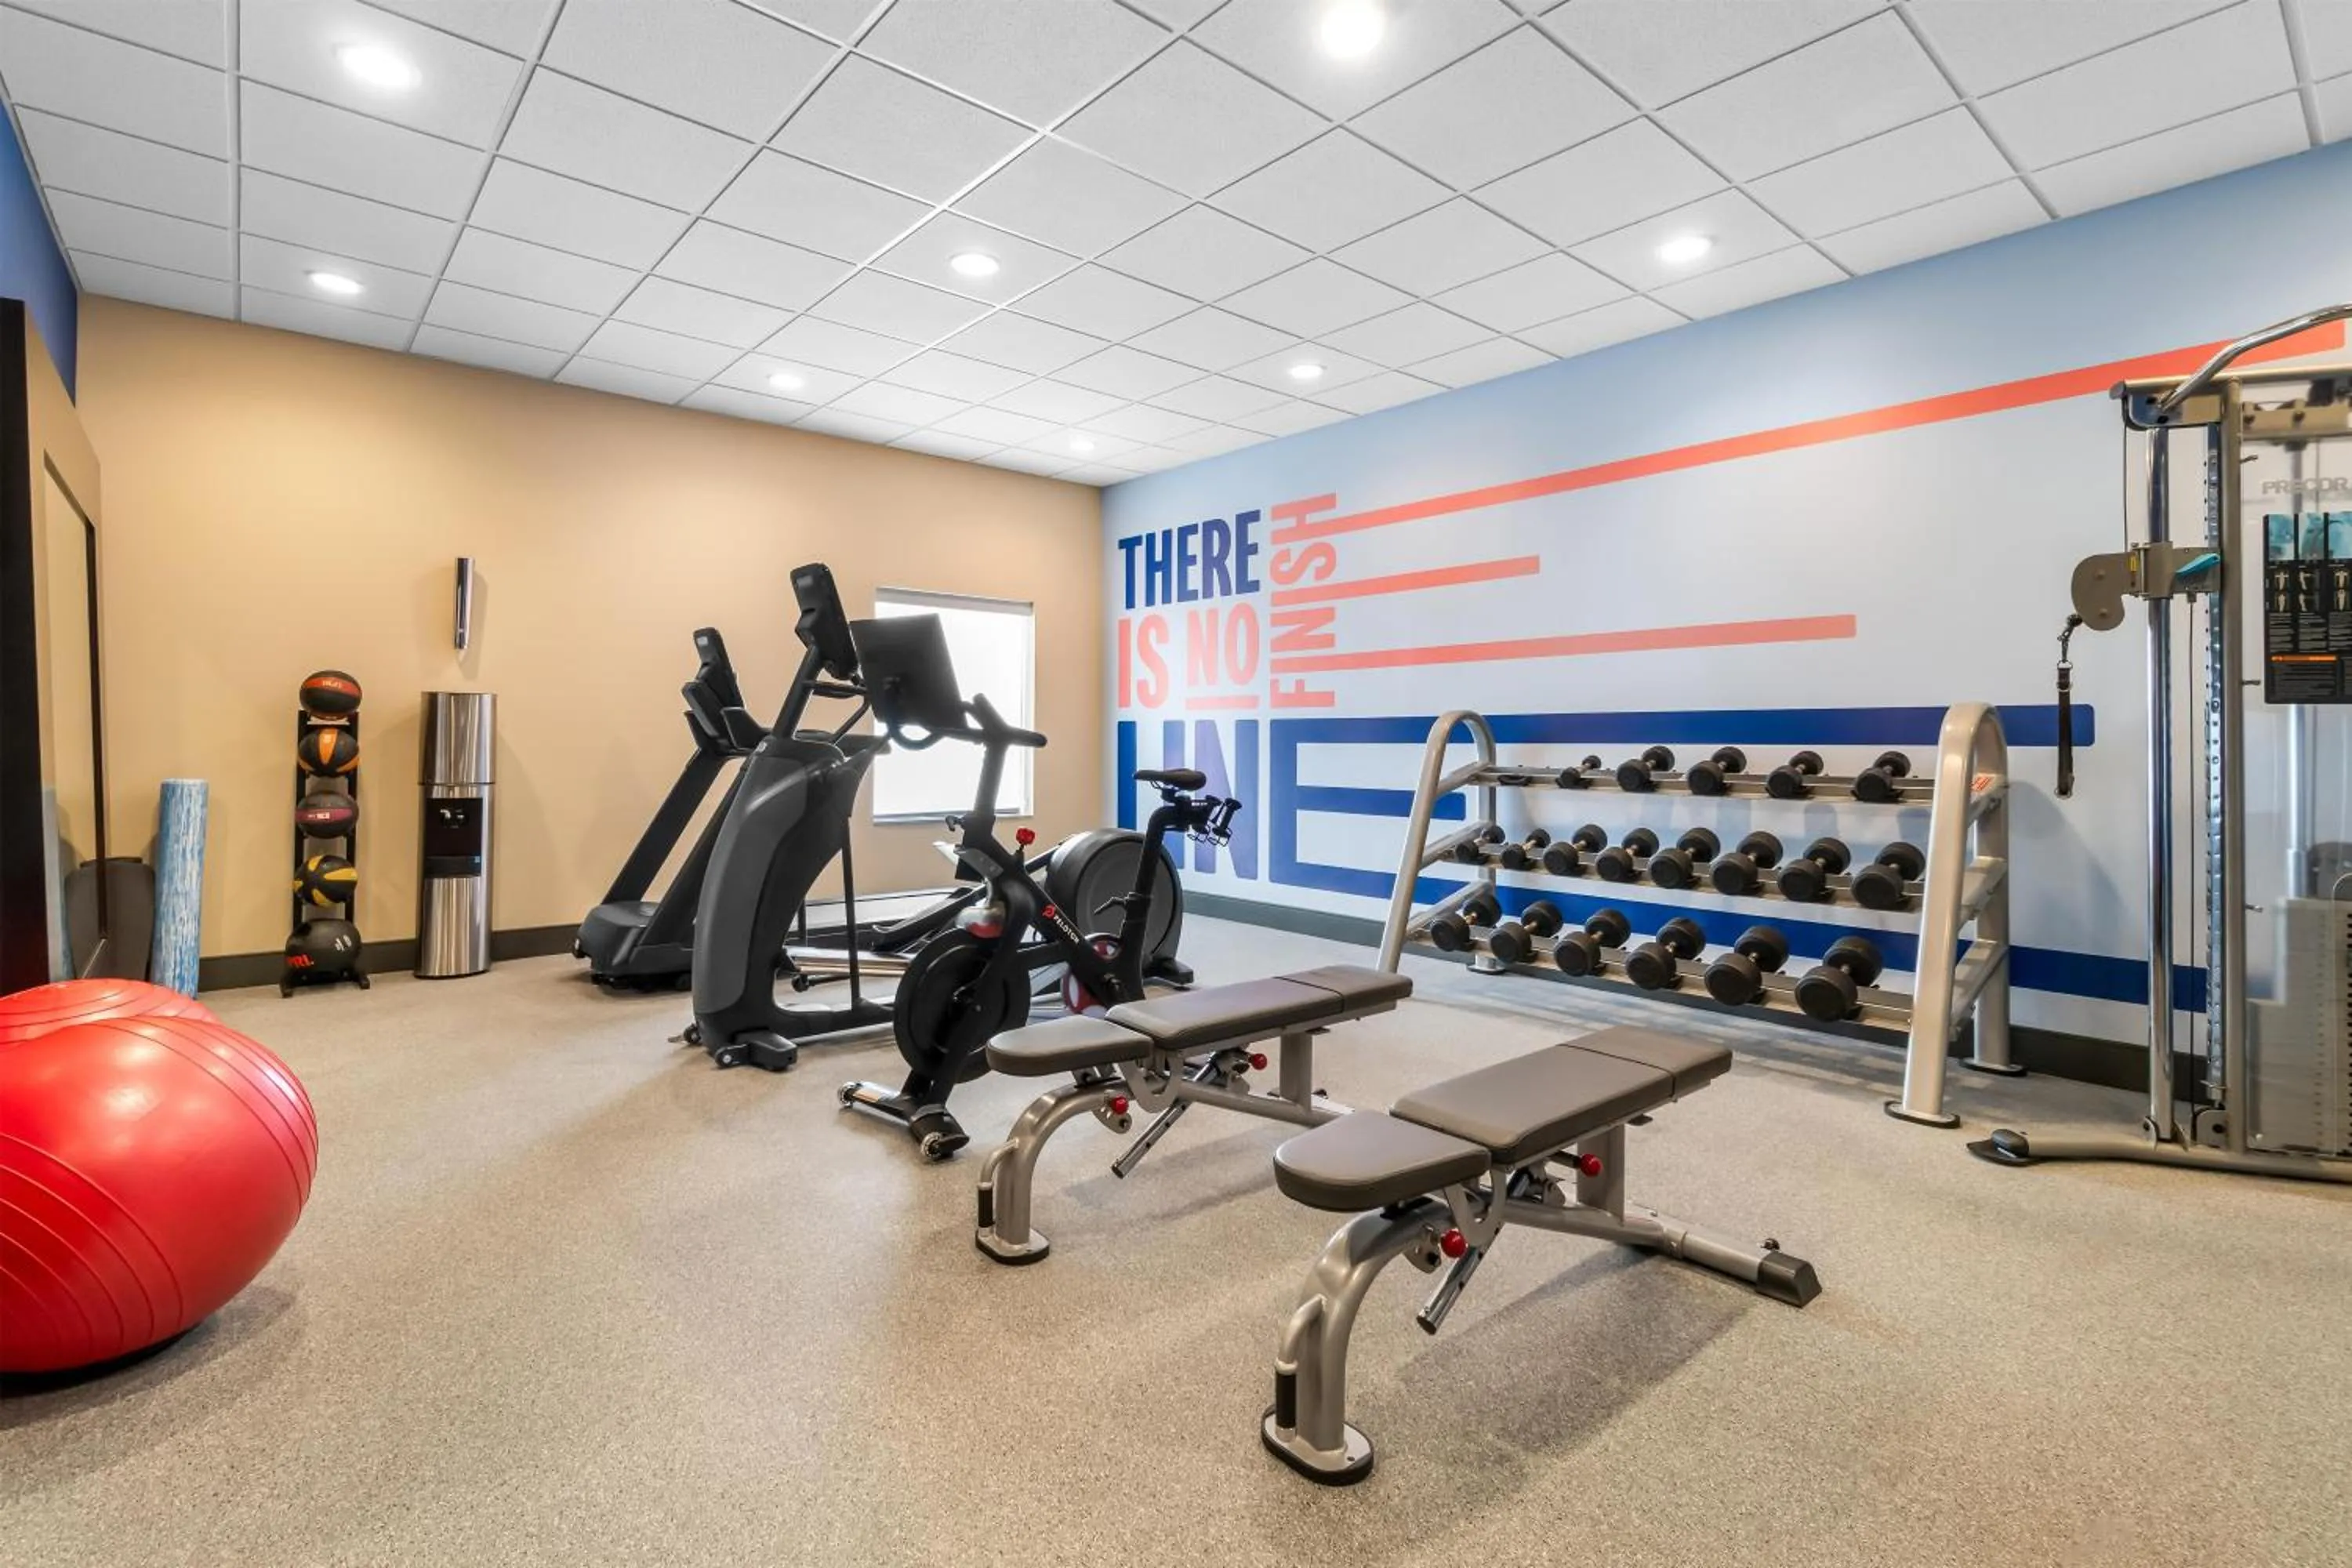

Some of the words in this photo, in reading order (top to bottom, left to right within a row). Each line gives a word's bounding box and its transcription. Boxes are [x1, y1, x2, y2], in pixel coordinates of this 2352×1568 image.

[2261, 477, 2349, 495] PRECOR
[1117, 509, 1261, 610] THERE
[1269, 492, 1338, 709] FINISH
[1118, 613, 1169, 709] IS
[1187, 602, 1260, 687] NO
